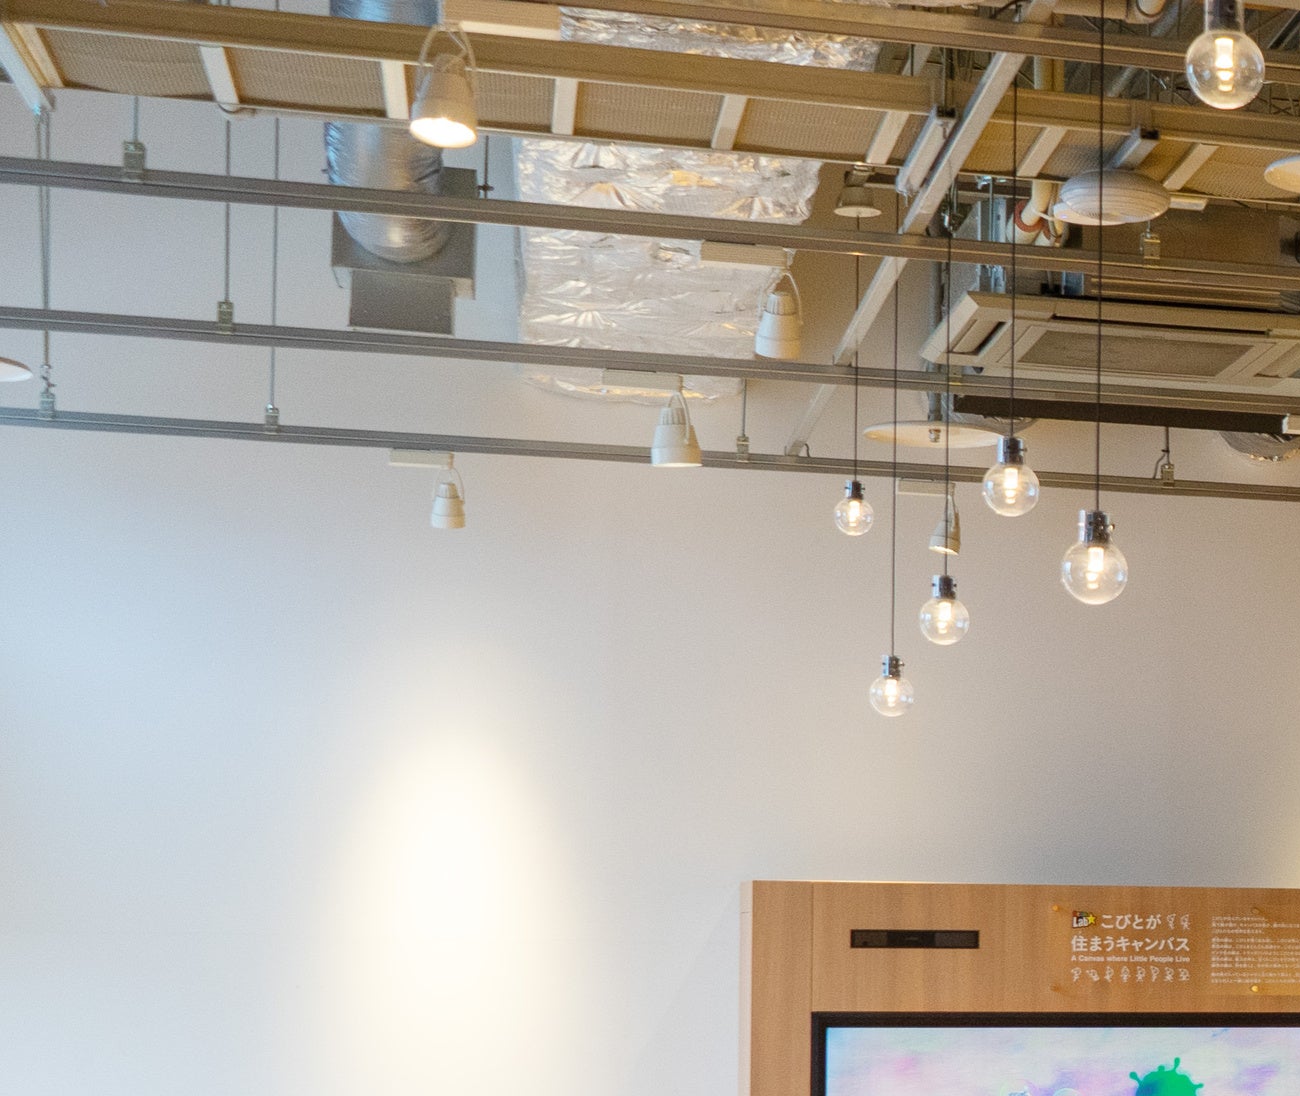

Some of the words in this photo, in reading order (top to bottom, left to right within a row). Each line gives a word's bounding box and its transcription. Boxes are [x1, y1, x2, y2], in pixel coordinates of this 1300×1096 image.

[1101, 913, 1162, 930] こびとが
[1071, 935, 1191, 952] 住まうキャンバス
[1106, 955, 1128, 963] where
[1129, 954, 1148, 963] Little
[1149, 955, 1174, 964] People
